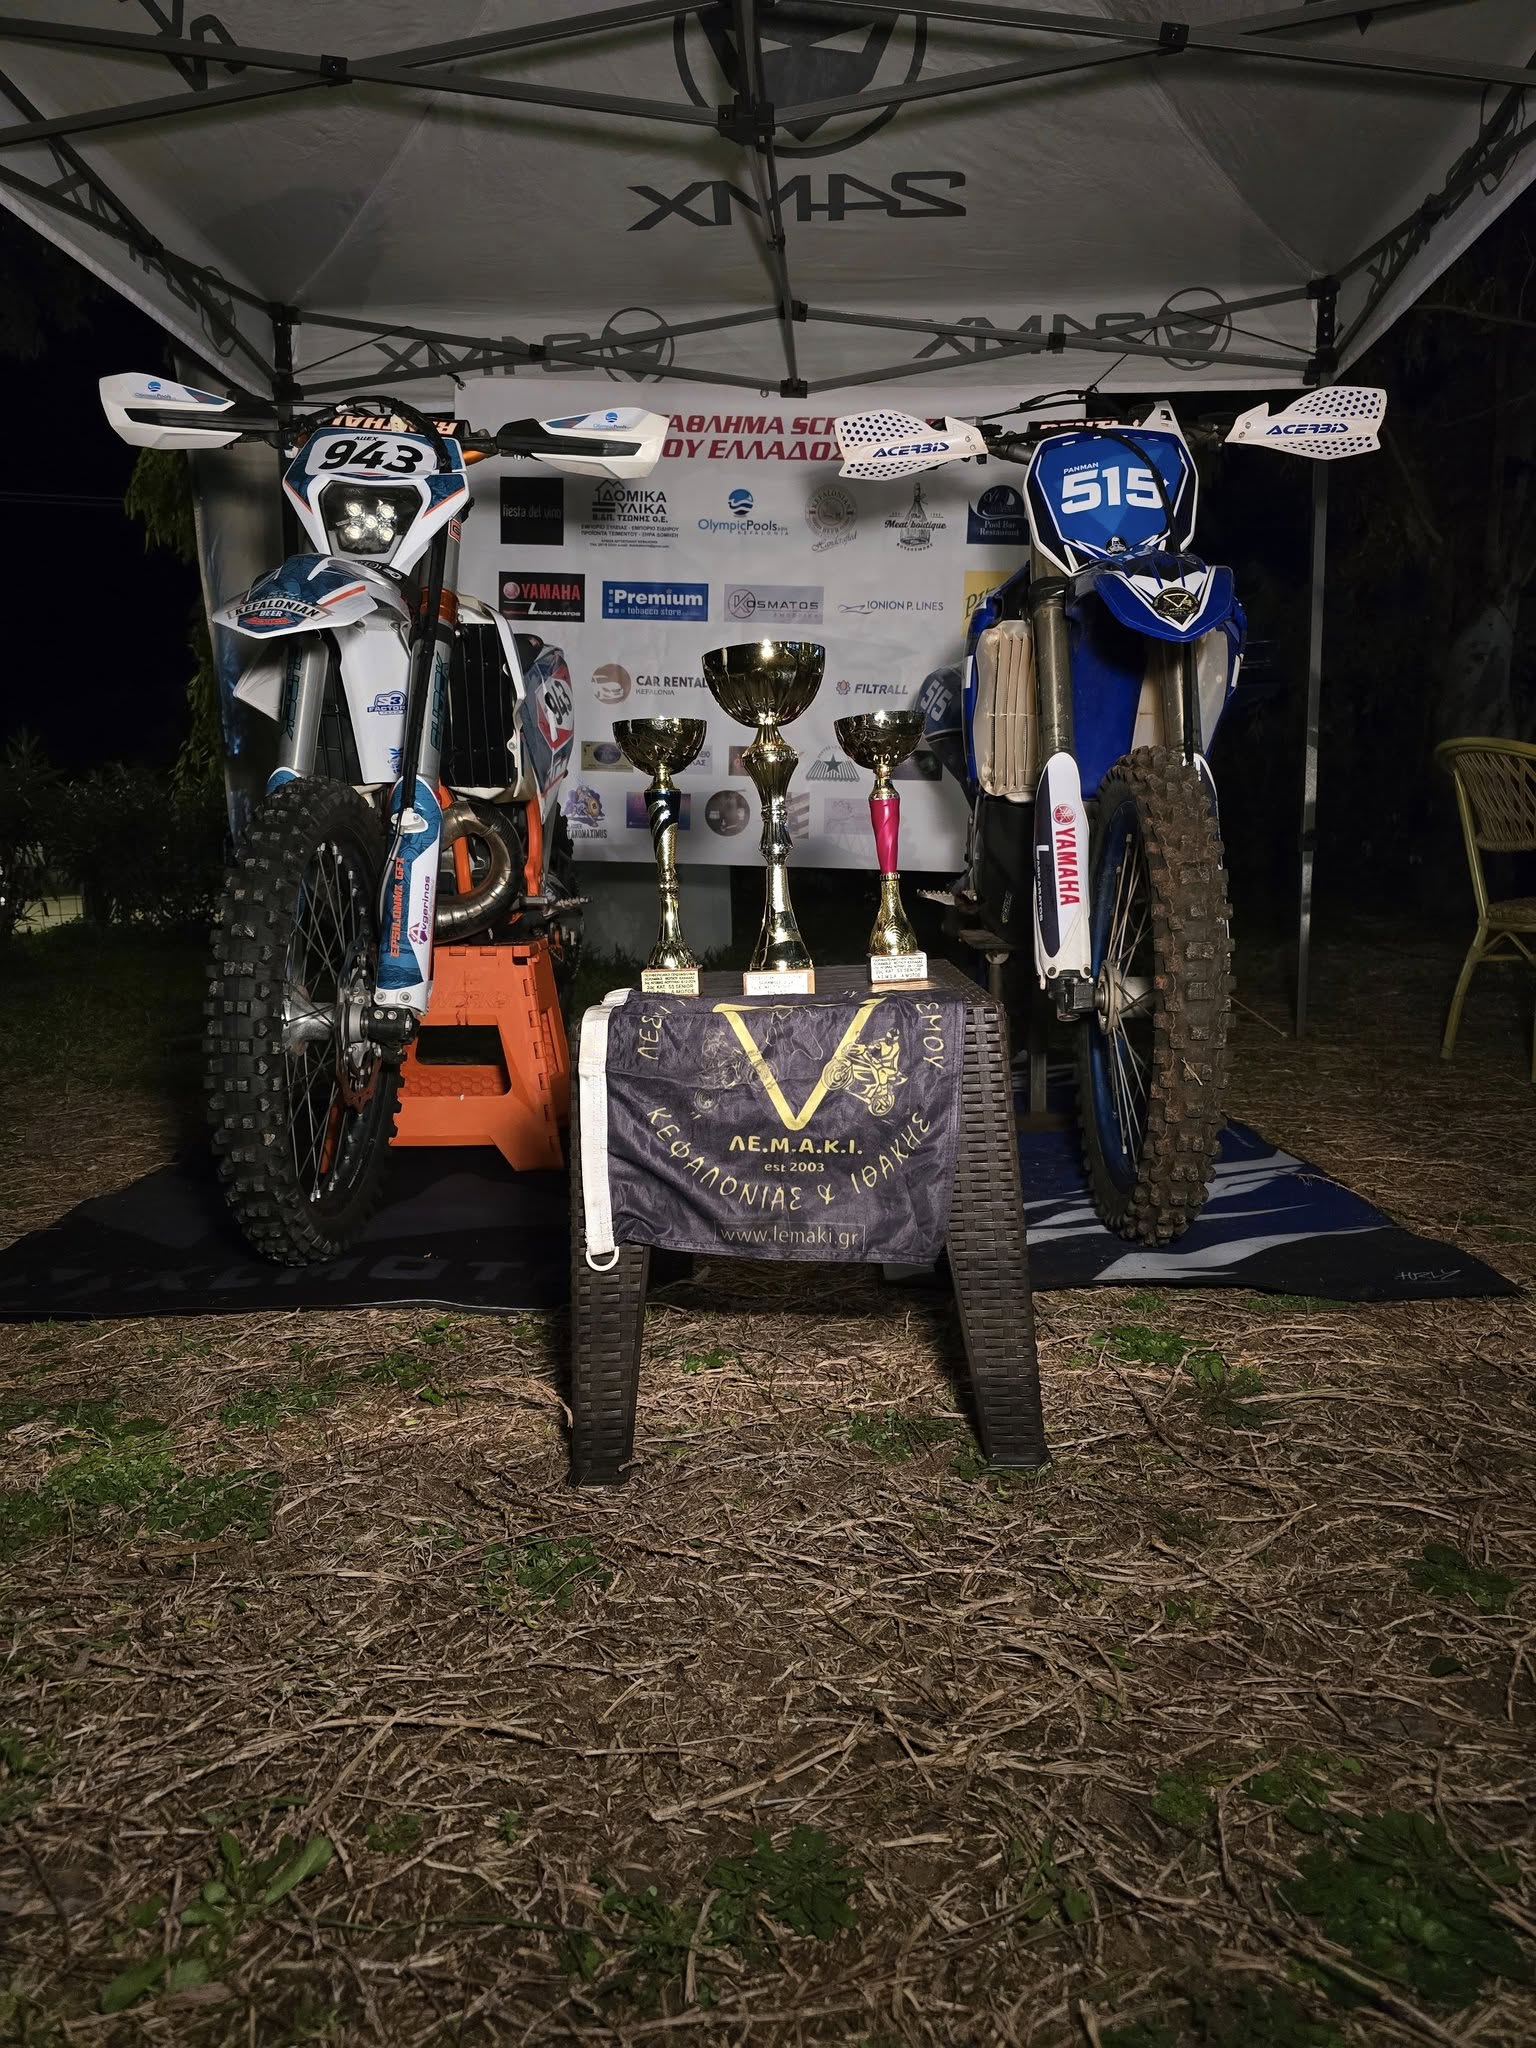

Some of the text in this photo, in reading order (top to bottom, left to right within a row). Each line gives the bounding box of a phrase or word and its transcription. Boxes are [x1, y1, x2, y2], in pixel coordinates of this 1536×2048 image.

[1266, 423, 1349, 435] ACERBIS
[318, 440, 423, 473] 943
[873, 442, 950, 458] ACERBIS
[1063, 462, 1099, 474] PANMAN
[602, 489, 667, 503] ΔΟΜΙΚΑ
[1061, 466, 1163, 514] 515
[617, 503, 667, 515] ΥΛΙΚΑ
[885, 520, 908, 528] Meat
[521, 583, 581, 600] YAMAHA
[614, 589, 704, 606] Premium
[235, 600, 320, 617] KEFALONIAN
[627, 607, 659, 615] tobacco
[660, 608, 682, 616] store
[867, 601, 904, 610] IONION
[916, 602, 944, 611] LINES
[636, 675, 660, 687] CAR
[854, 683, 909, 695] FILTRALL
[544, 680, 572, 725] 943
[920, 679, 953, 721] 515
[395, 857, 405, 880] GFX
[1055, 827, 1080, 906] YAMAHA
[764, 1162, 825, 1173] est 2003
[720, 1225, 859, 1250] www.lemaki.gr
